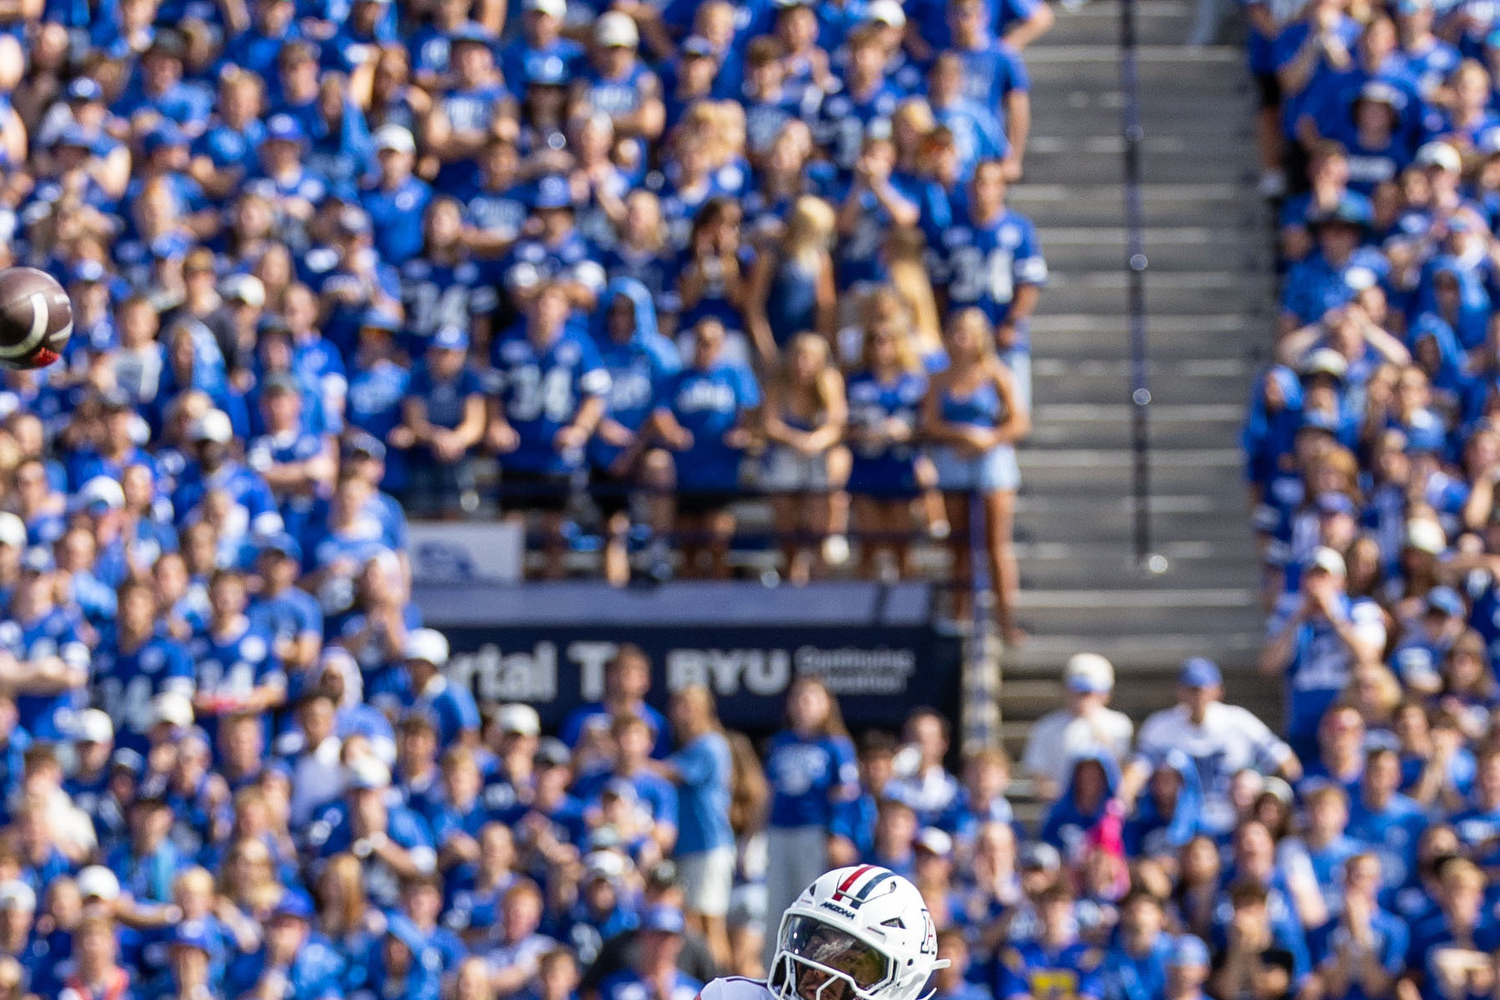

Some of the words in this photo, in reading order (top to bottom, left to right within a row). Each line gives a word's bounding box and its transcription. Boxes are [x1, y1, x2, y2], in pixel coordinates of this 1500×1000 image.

[508, 363, 573, 423] 34
[452, 642, 558, 700] rtal
[667, 647, 791, 695] BYU
[820, 901, 856, 920] ARIZONA
